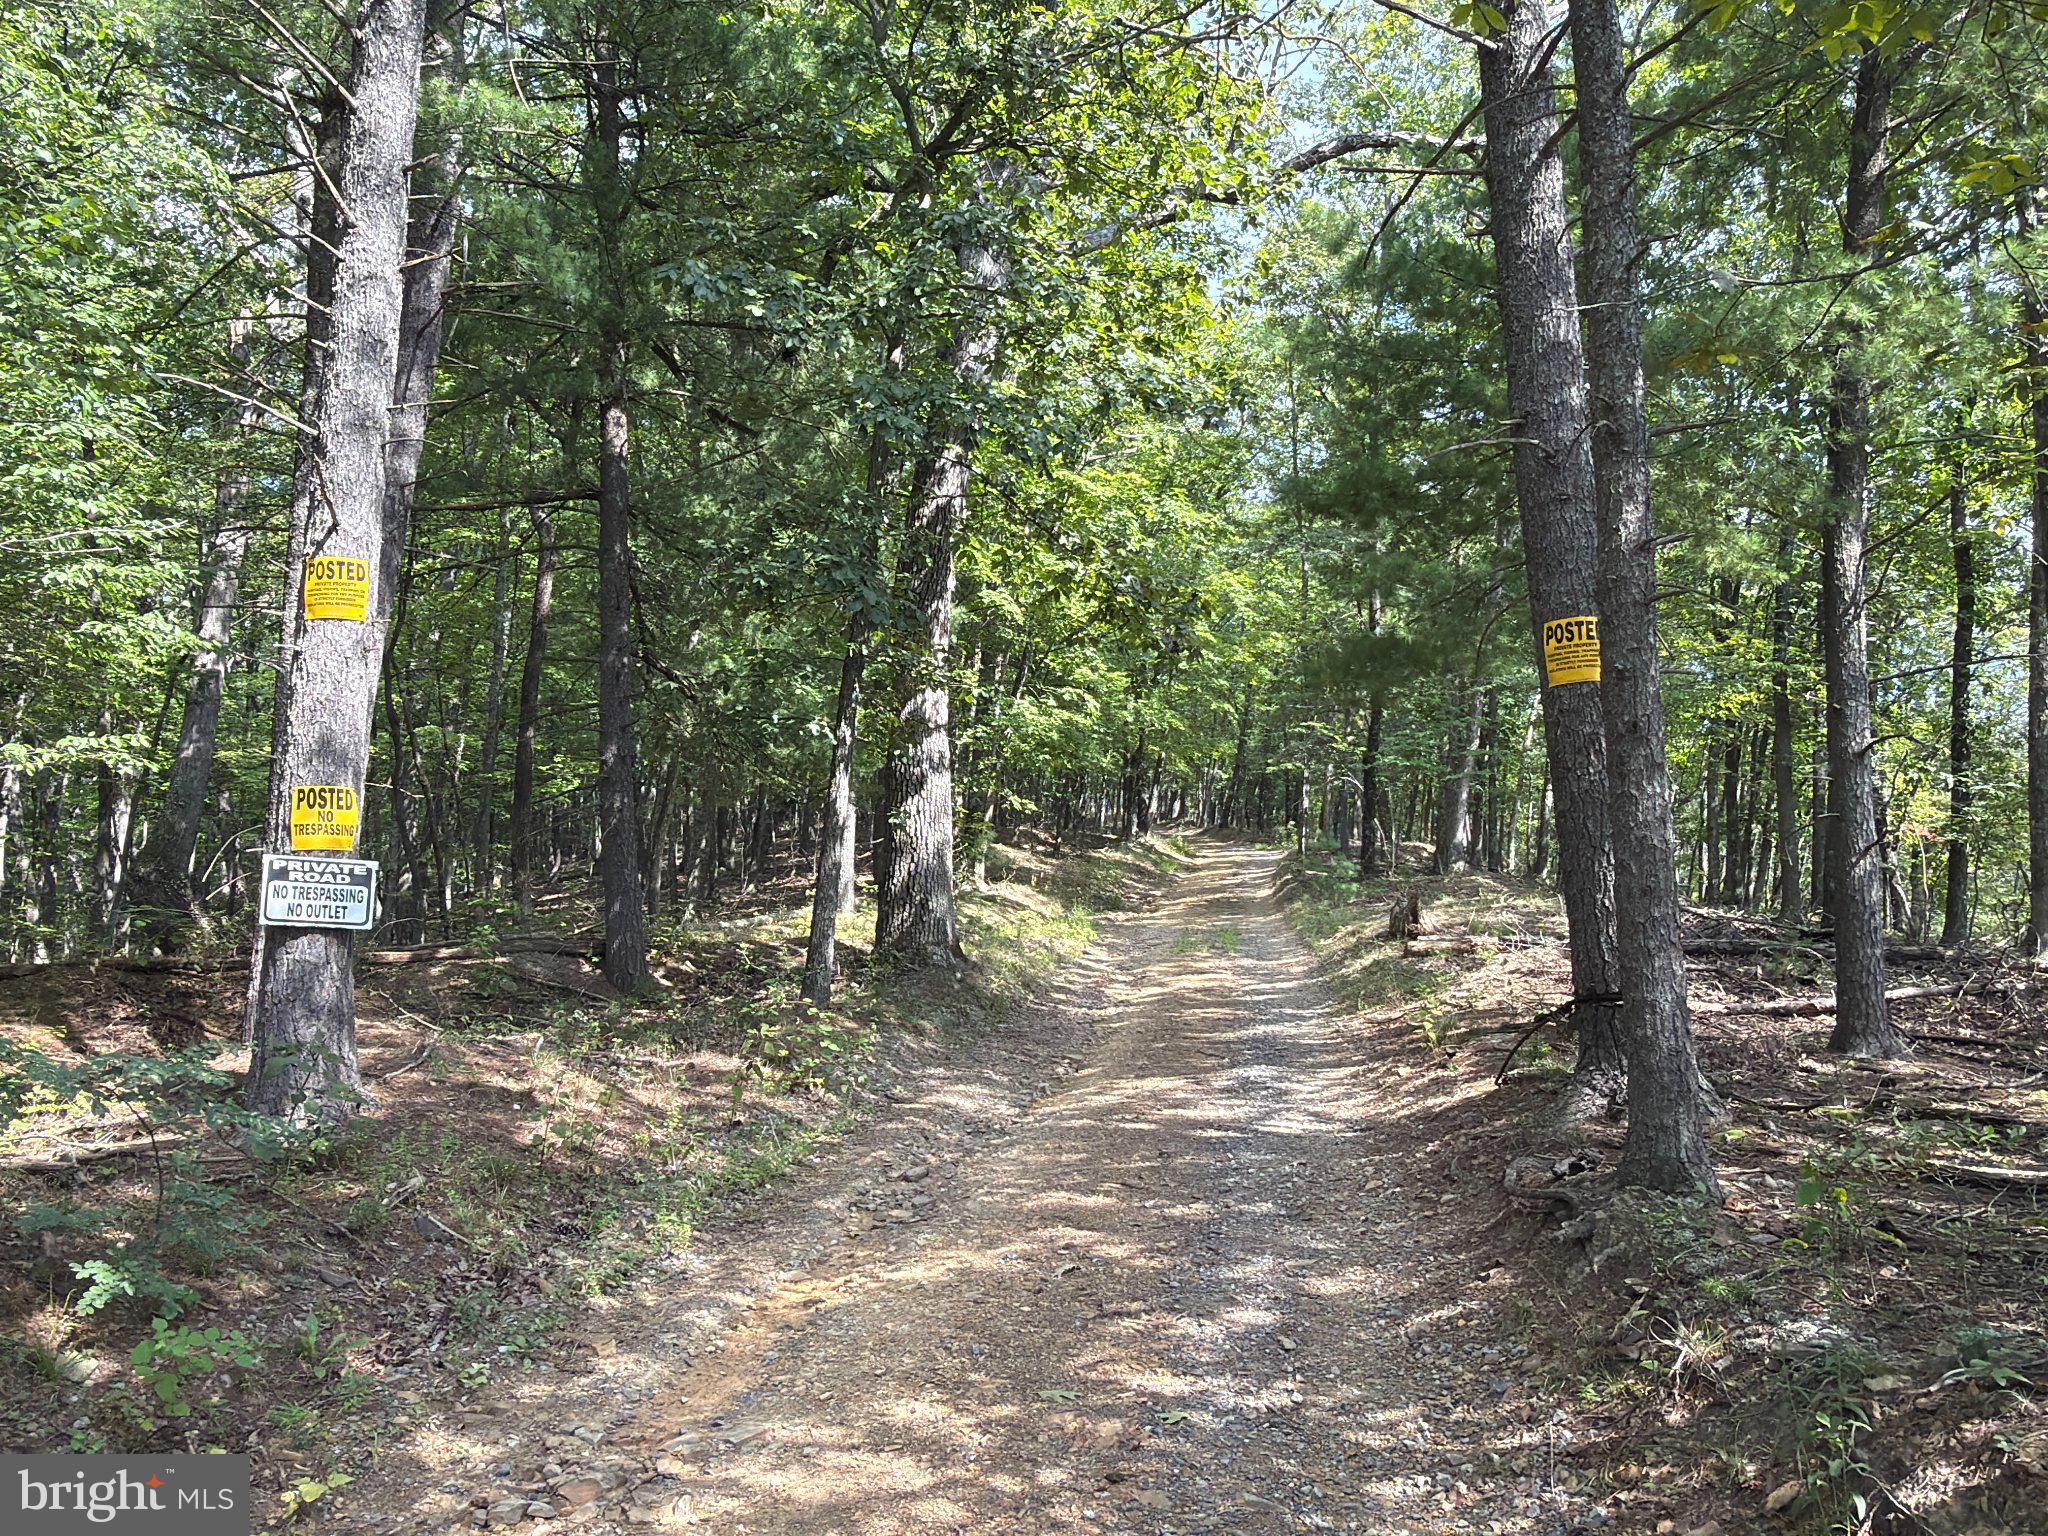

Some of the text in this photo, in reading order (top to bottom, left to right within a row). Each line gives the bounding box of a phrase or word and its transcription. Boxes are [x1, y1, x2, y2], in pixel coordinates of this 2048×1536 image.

[307, 560, 366, 581] POSTED
[1545, 620, 1598, 647] POSTE
[296, 787, 353, 811] POSTED
[317, 810, 334, 823] NO
[293, 823, 355, 837] TRESPASSING
[272, 859, 368, 876] PRIVATE
[288, 871, 351, 884] ROAD
[272, 884, 365, 904] NO TRESPASSING
[286, 902, 349, 920] NO OUTLET
